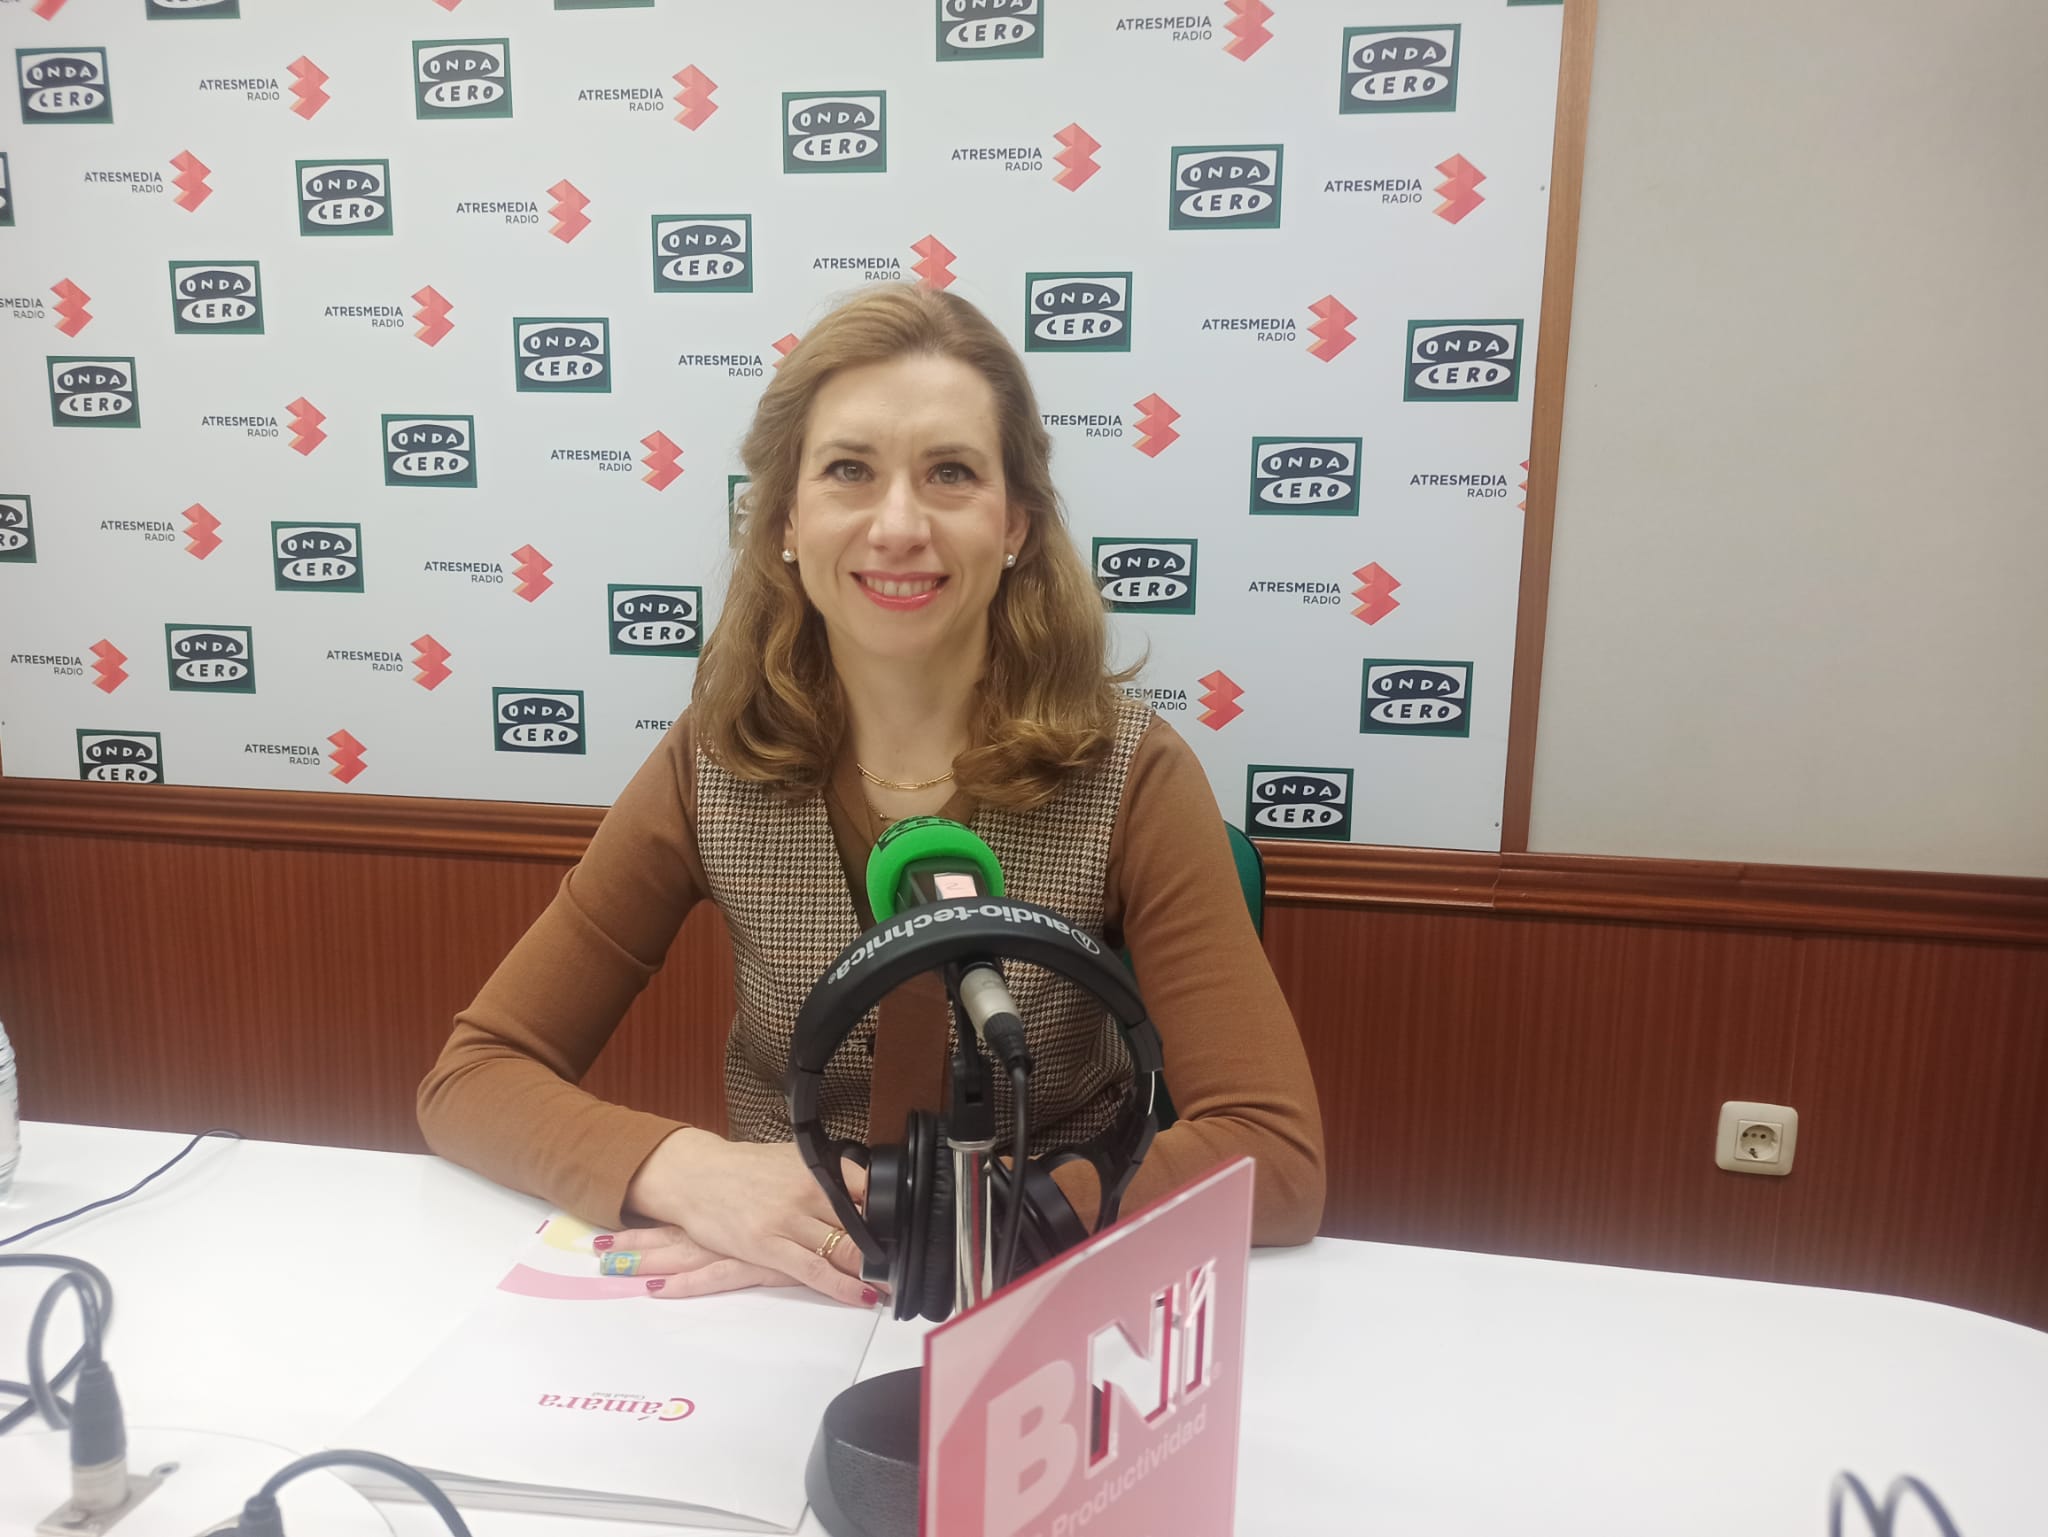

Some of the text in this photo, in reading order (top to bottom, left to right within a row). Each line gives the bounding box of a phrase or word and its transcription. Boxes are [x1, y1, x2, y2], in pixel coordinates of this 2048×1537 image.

[1115, 15, 1212, 31] ATRESMEDIA
[958, 23, 1024, 43] CERO
[1172, 30, 1213, 41] RADIO
[1361, 46, 1437, 64] ONDA
[32, 65, 92, 81] ONDA
[430, 58, 492, 74] ONDA
[199, 78, 279, 91] ATRESMEDIA
[1364, 75, 1436, 95] CERO
[39, 91, 94, 108] CERO
[246, 91, 280, 101] RADIO
[435, 84, 494, 103] CERO
[577, 87, 664, 101] ATRESMEDIA
[629, 101, 665, 112] RADIO
[800, 111, 867, 127] ONDA
[803, 138, 867, 156] CERO
[951, 147, 1043, 161] ATRESMEDIA
[1005, 160, 1043, 172] RADIO
[84, 171, 163, 183] ATRESMEDIA
[1189, 165, 1261, 182] ONDA
[131, 184, 164, 194] RADIO
[312, 178, 373, 193] ONDA
[1323, 178, 1423, 193] ATRESMEDIA
[1192, 193, 1261, 212] CERO
[1381, 193, 1423, 204] RADIO
[317, 203, 375, 220] CERO
[455, 201, 539, 214] ATRESMEDIA
[505, 214, 540, 224] RADIO
[669, 233, 733, 248] ONDA
[673, 259, 734, 276] CERO
[812, 257, 901, 270] ATRESMEDIA
[864, 270, 901, 281] RADIO
[186, 279, 245, 292] ONDA
[0, 297, 44, 309] SMEDIA
[1043, 291, 1112, 307] ONDA
[13, 310, 46, 319] RADIO
[191, 303, 246, 319] CERO
[324, 305, 404, 317] ATRESMEDIA
[371, 318, 405, 328] RADIO
[1046, 318, 1112, 335] CERO
[1201, 318, 1296, 331] ATRESMEDIA
[530, 335, 592, 350] ONDA
[1257, 331, 1296, 342] RADIO
[1425, 339, 1500, 355] ONDA
[677, 354, 763, 366] ATRESMEDIA
[534, 360, 593, 377] CERO
[728, 367, 764, 377] RADIO
[1427, 366, 1499, 385] CERO
[63, 373, 121, 387] ONDA
[69, 397, 123, 412] CERO
[201, 415, 279, 427] ATRESMEDIA
[1041, 414, 1123, 427] TRESMEDIA
[247, 428, 279, 438] RADIO
[398, 431, 458, 445] ONDA
[1085, 427, 1123, 438] RADIO
[550, 449, 632, 462] ATRESMEDIA
[402, 456, 459, 471] CERO
[598, 462, 633, 472] RADIO
[1269, 456, 1340, 471] ONDA
[1409, 473, 1508, 487] ATRESMEDIA
[1272, 482, 1340, 499] CERO
[1467, 487, 1508, 498] RADIO
[100, 519, 175, 532] ATRESMEDIA
[144, 532, 176, 542] RADIO
[287, 539, 345, 552] ONDA
[291, 562, 347, 577] CERO
[423, 560, 503, 574] ATRESMEDIA
[1109, 556, 1177, 570] ONDA
[471, 574, 504, 584] RADIO
[1112, 581, 1177, 597] CERO
[1248, 581, 1341, 594] ATRESMEDIA
[1302, 595, 1342, 606] RADIO
[623, 602, 685, 615] ONDA
[627, 625, 686, 641] CERO
[181, 641, 237, 653] ONDA
[10, 654, 83, 666] ATRESMEDIA
[326, 649, 403, 663] ATRESMEDIA
[53, 666, 84, 676] RADIO
[185, 663, 239, 677] CERO
[372, 662, 404, 673] RADIO
[1380, 677, 1451, 692] ONDA
[508, 705, 567, 717] ONDA
[1150, 701, 1188, 712] RADIO
[1383, 703, 1450, 719] CERO
[512, 727, 569, 742] CERO
[92, 745, 147, 758] ONDA
[244, 743, 320, 756] ATRESMEDIA
[289, 756, 321, 766] RADIO
[97, 767, 148, 782] CERO
[1264, 783, 1333, 797] ONDA
[1267, 807, 1332, 824] CERO
[835, 904, 1072, 981] audio-technica
[984, 1259, 1215, 1537] BNI
[538, 1393, 695, 1421] Cámara
[1051, 1405, 1207, 1537] Productividad
